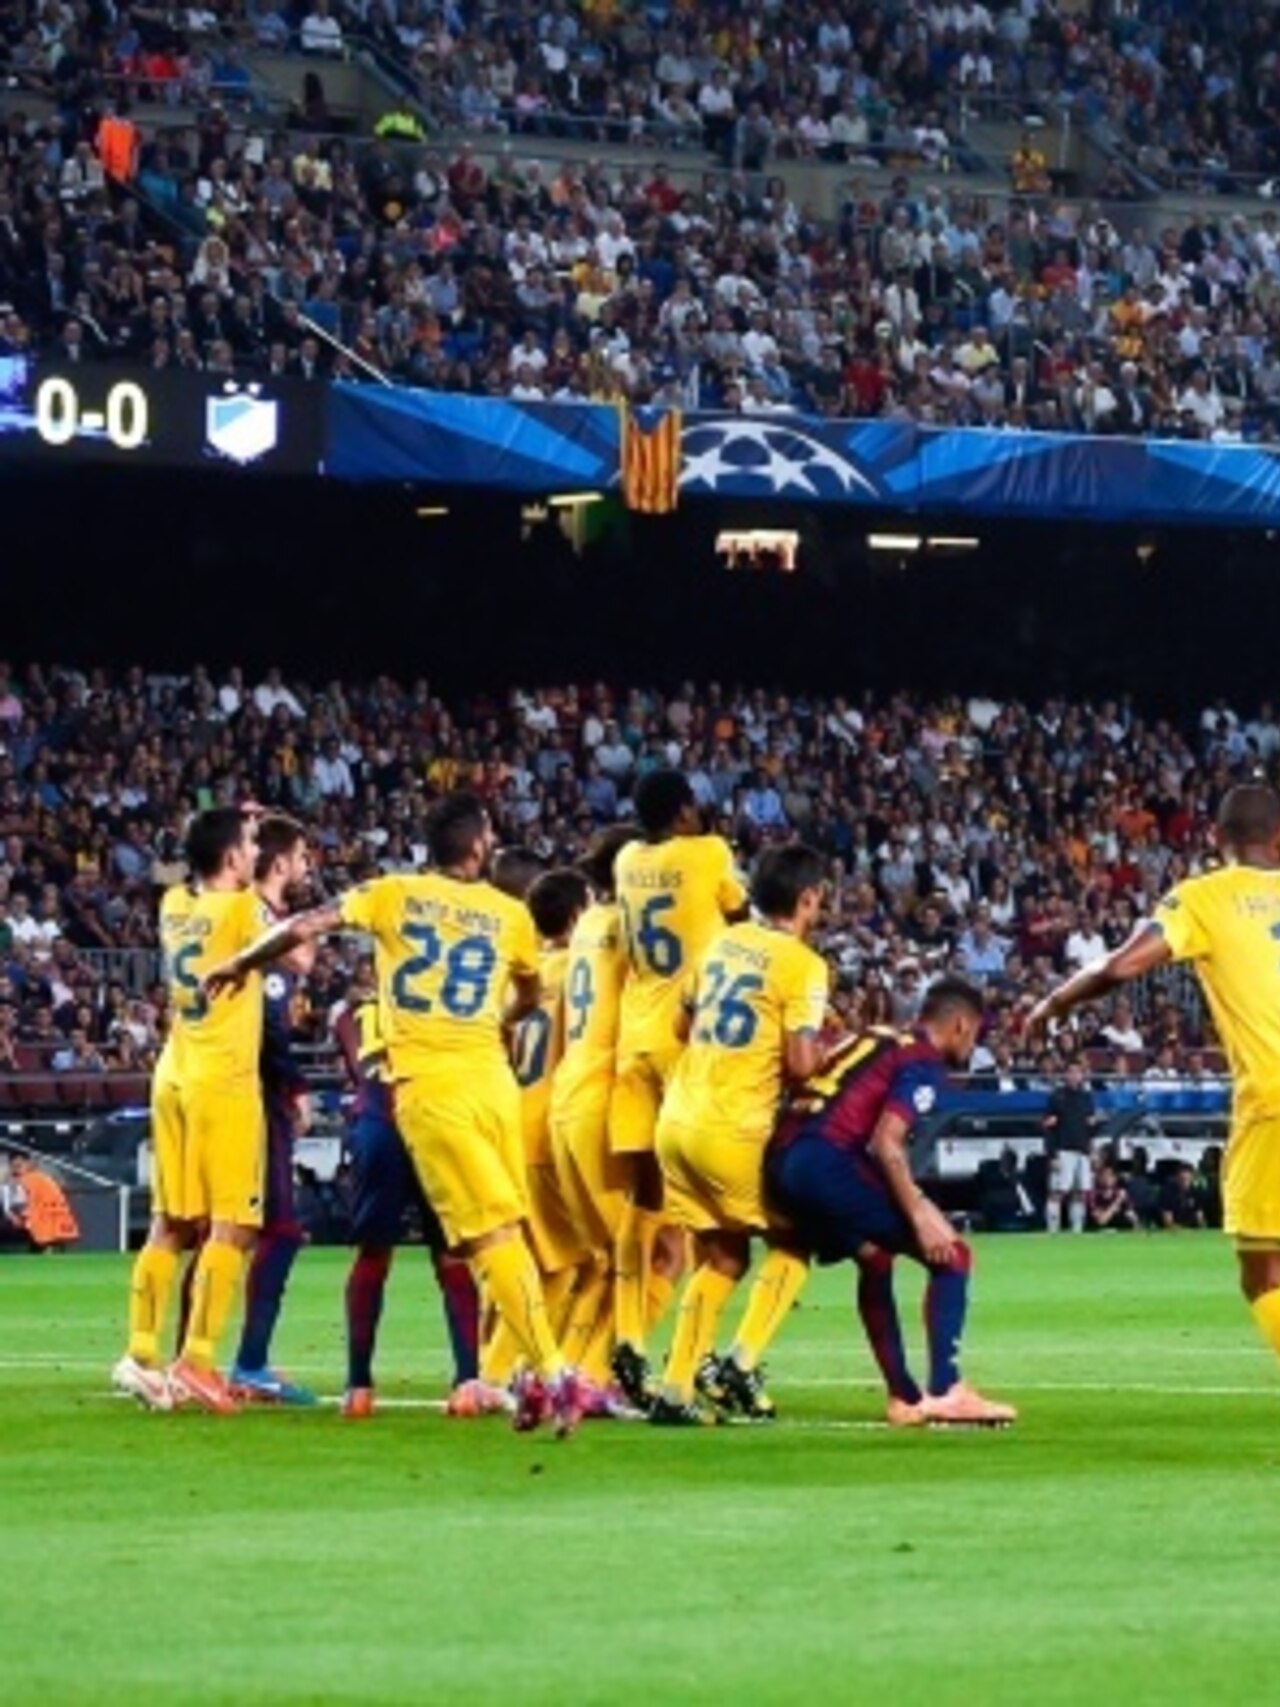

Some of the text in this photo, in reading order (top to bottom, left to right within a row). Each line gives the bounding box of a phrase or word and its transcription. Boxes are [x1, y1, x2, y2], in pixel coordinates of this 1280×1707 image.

[37, 376, 149, 449] 0-0
[173, 941, 209, 1022] 5
[392, 922, 497, 1019] 28
[696, 960, 763, 1049] 26
